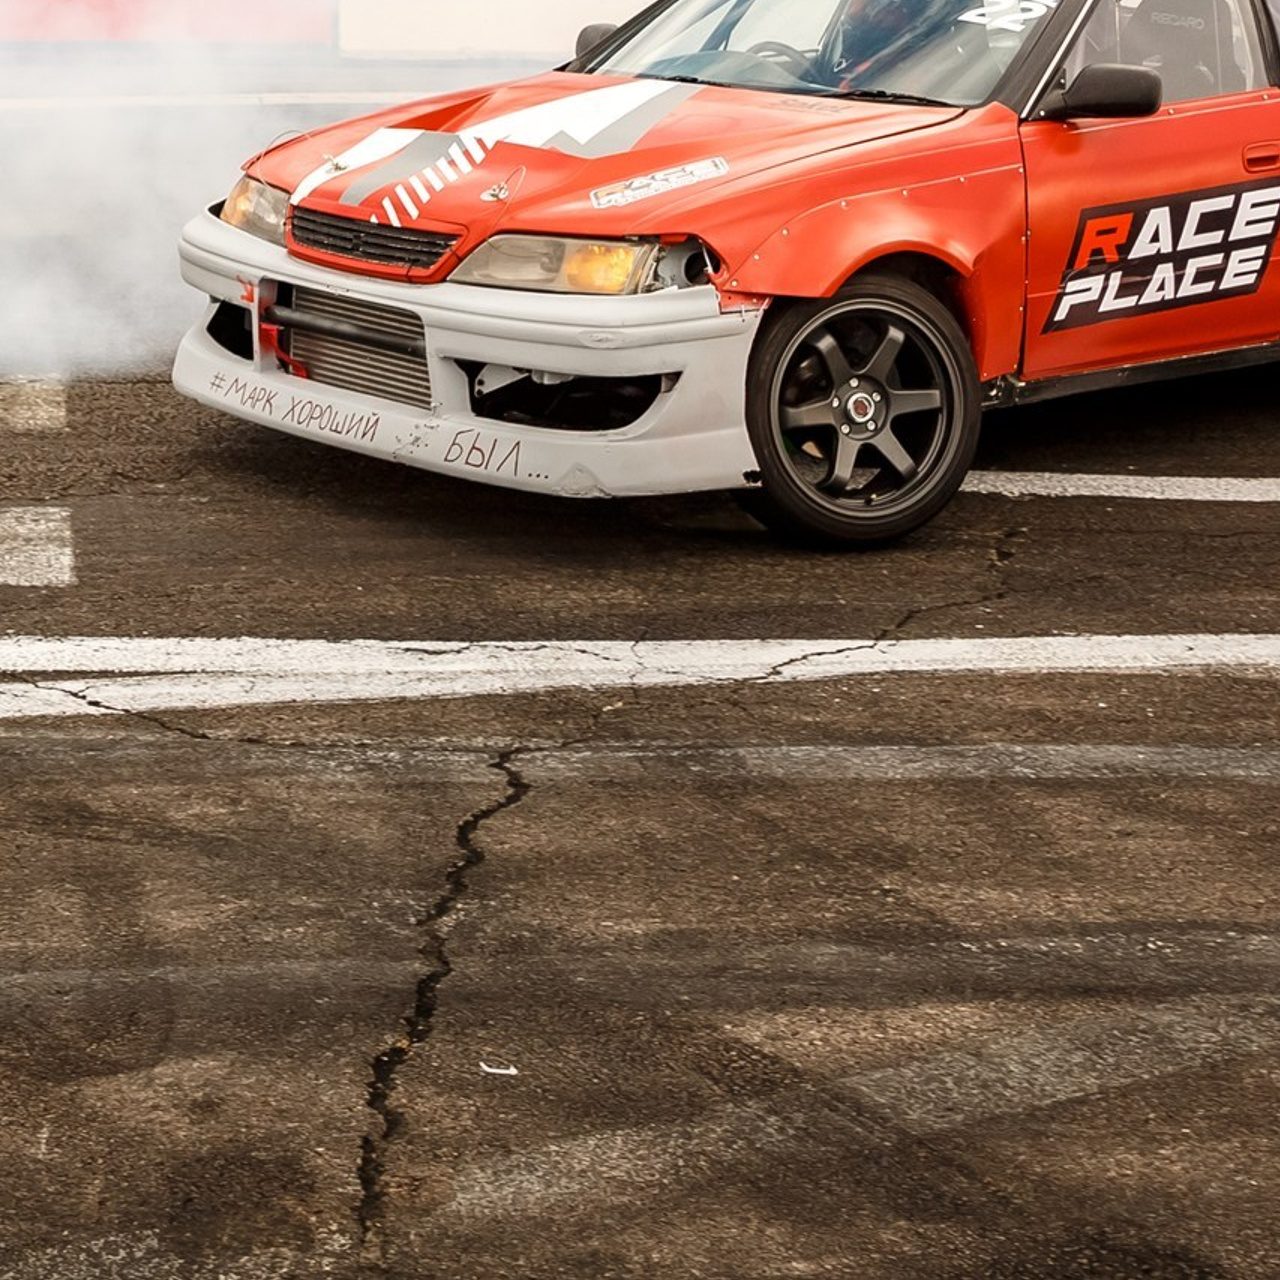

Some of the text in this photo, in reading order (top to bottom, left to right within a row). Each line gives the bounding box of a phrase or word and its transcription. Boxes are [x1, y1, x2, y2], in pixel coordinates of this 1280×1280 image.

[1073, 185, 1280, 270] RACE
[1053, 244, 1268, 321] PLACE
[209, 370, 279, 416] #МАРК
[282, 395, 381, 443] ХОРОШИЙ
